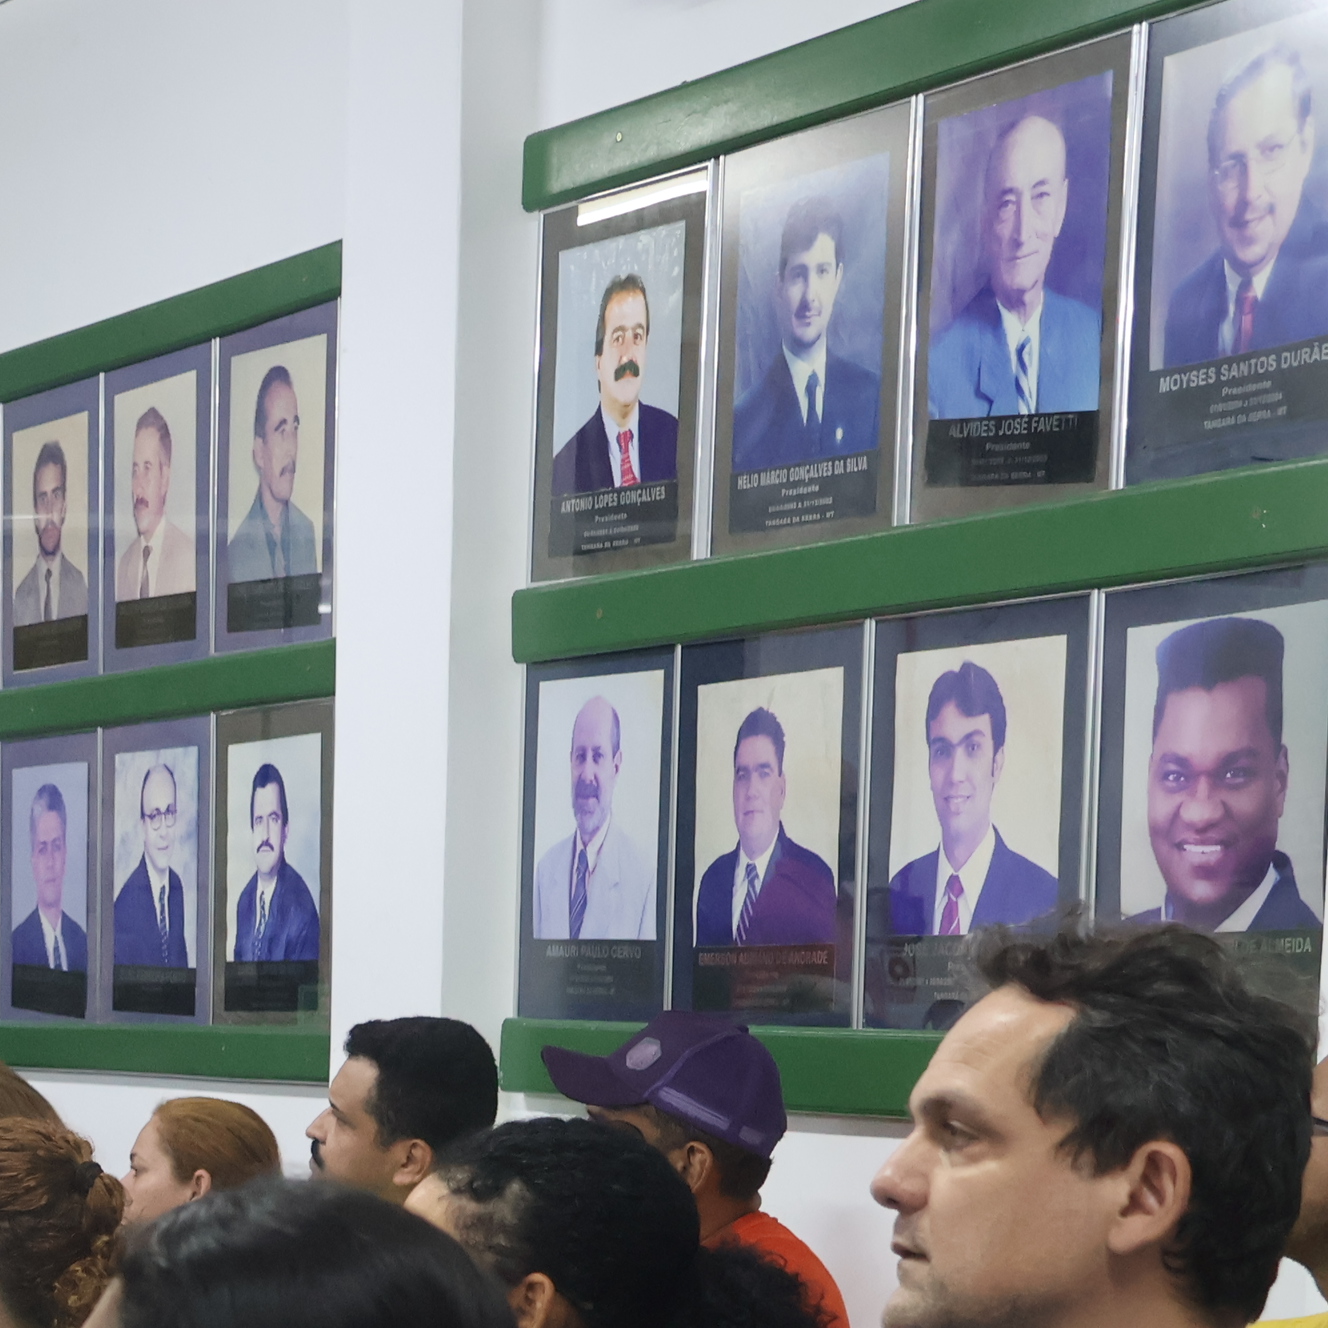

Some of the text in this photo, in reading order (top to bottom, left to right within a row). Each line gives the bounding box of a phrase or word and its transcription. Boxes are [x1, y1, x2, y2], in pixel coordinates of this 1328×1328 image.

[1159, 367, 1216, 394] MOYSES
[1220, 354, 1277, 381] SANTOS
[998, 414, 1028, 436] JOSÉ
[789, 460, 832, 482] GONÇALVES
[834, 460, 844, 475] DA
[846, 455, 868, 472] SILVA
[594, 493, 618, 510] LOPES
[620, 486, 666, 506] GONÇALVES
